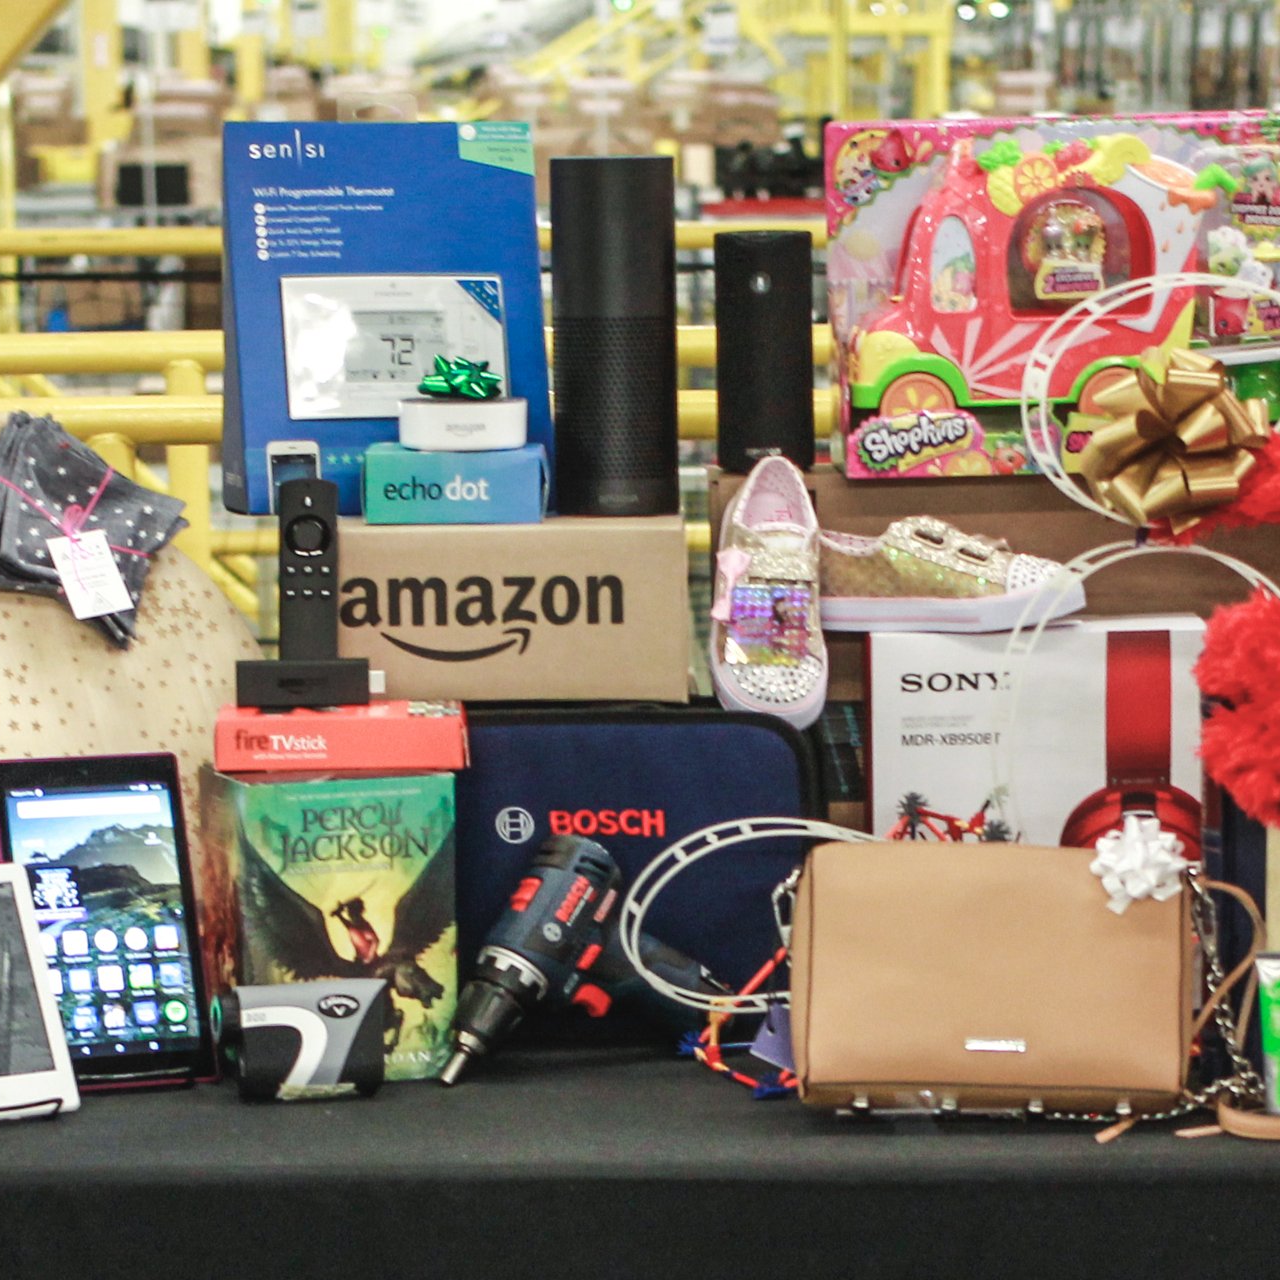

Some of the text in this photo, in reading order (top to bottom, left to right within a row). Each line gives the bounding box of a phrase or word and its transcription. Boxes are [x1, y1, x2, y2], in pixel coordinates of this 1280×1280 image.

[381, 337, 415, 365] 72
[864, 414, 967, 462] Shopkins
[384, 474, 490, 501] echo dot
[340, 574, 624, 628] amazon
[301, 800, 403, 834] PERCY
[548, 808, 666, 838] BOSCH
[280, 826, 431, 873] JACKSON
